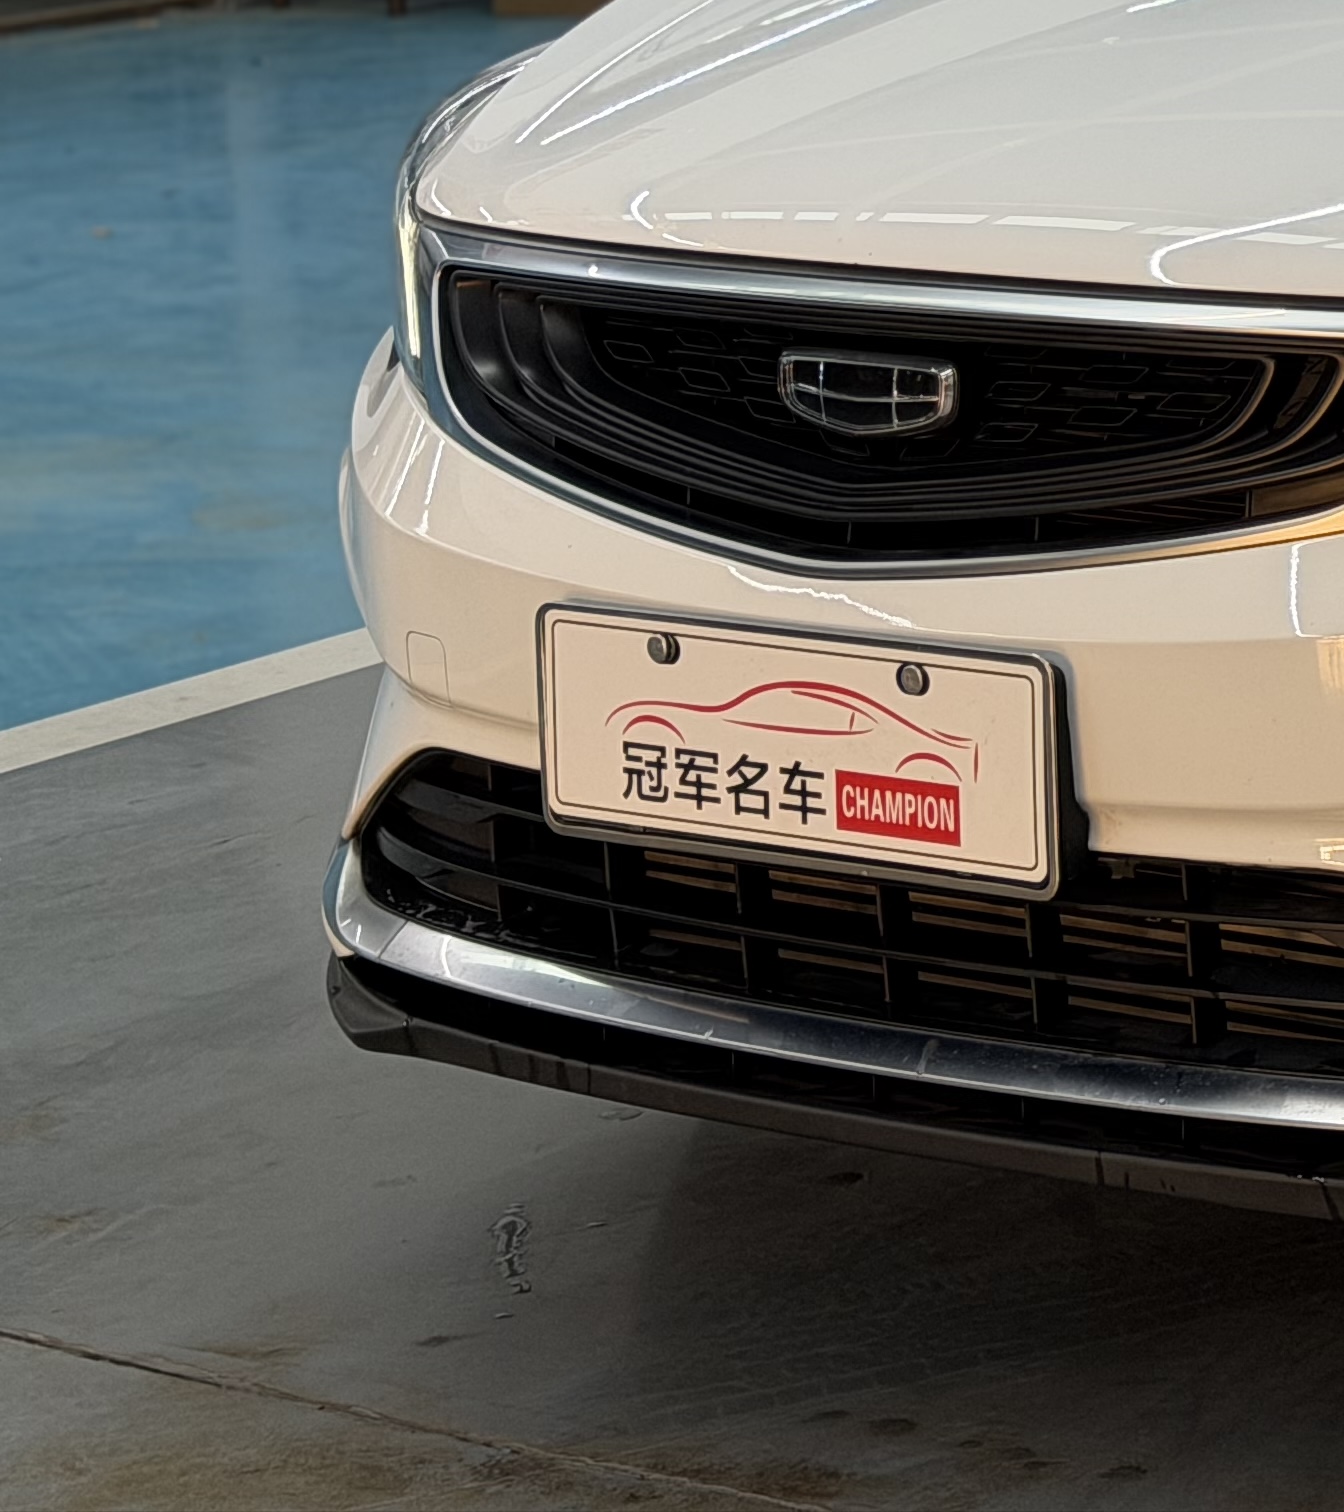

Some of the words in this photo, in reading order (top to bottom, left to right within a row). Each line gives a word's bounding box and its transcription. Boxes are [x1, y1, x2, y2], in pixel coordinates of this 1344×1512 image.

[621, 739, 827, 826] 冠军名车
[841, 783, 956, 834] CHAMPION
